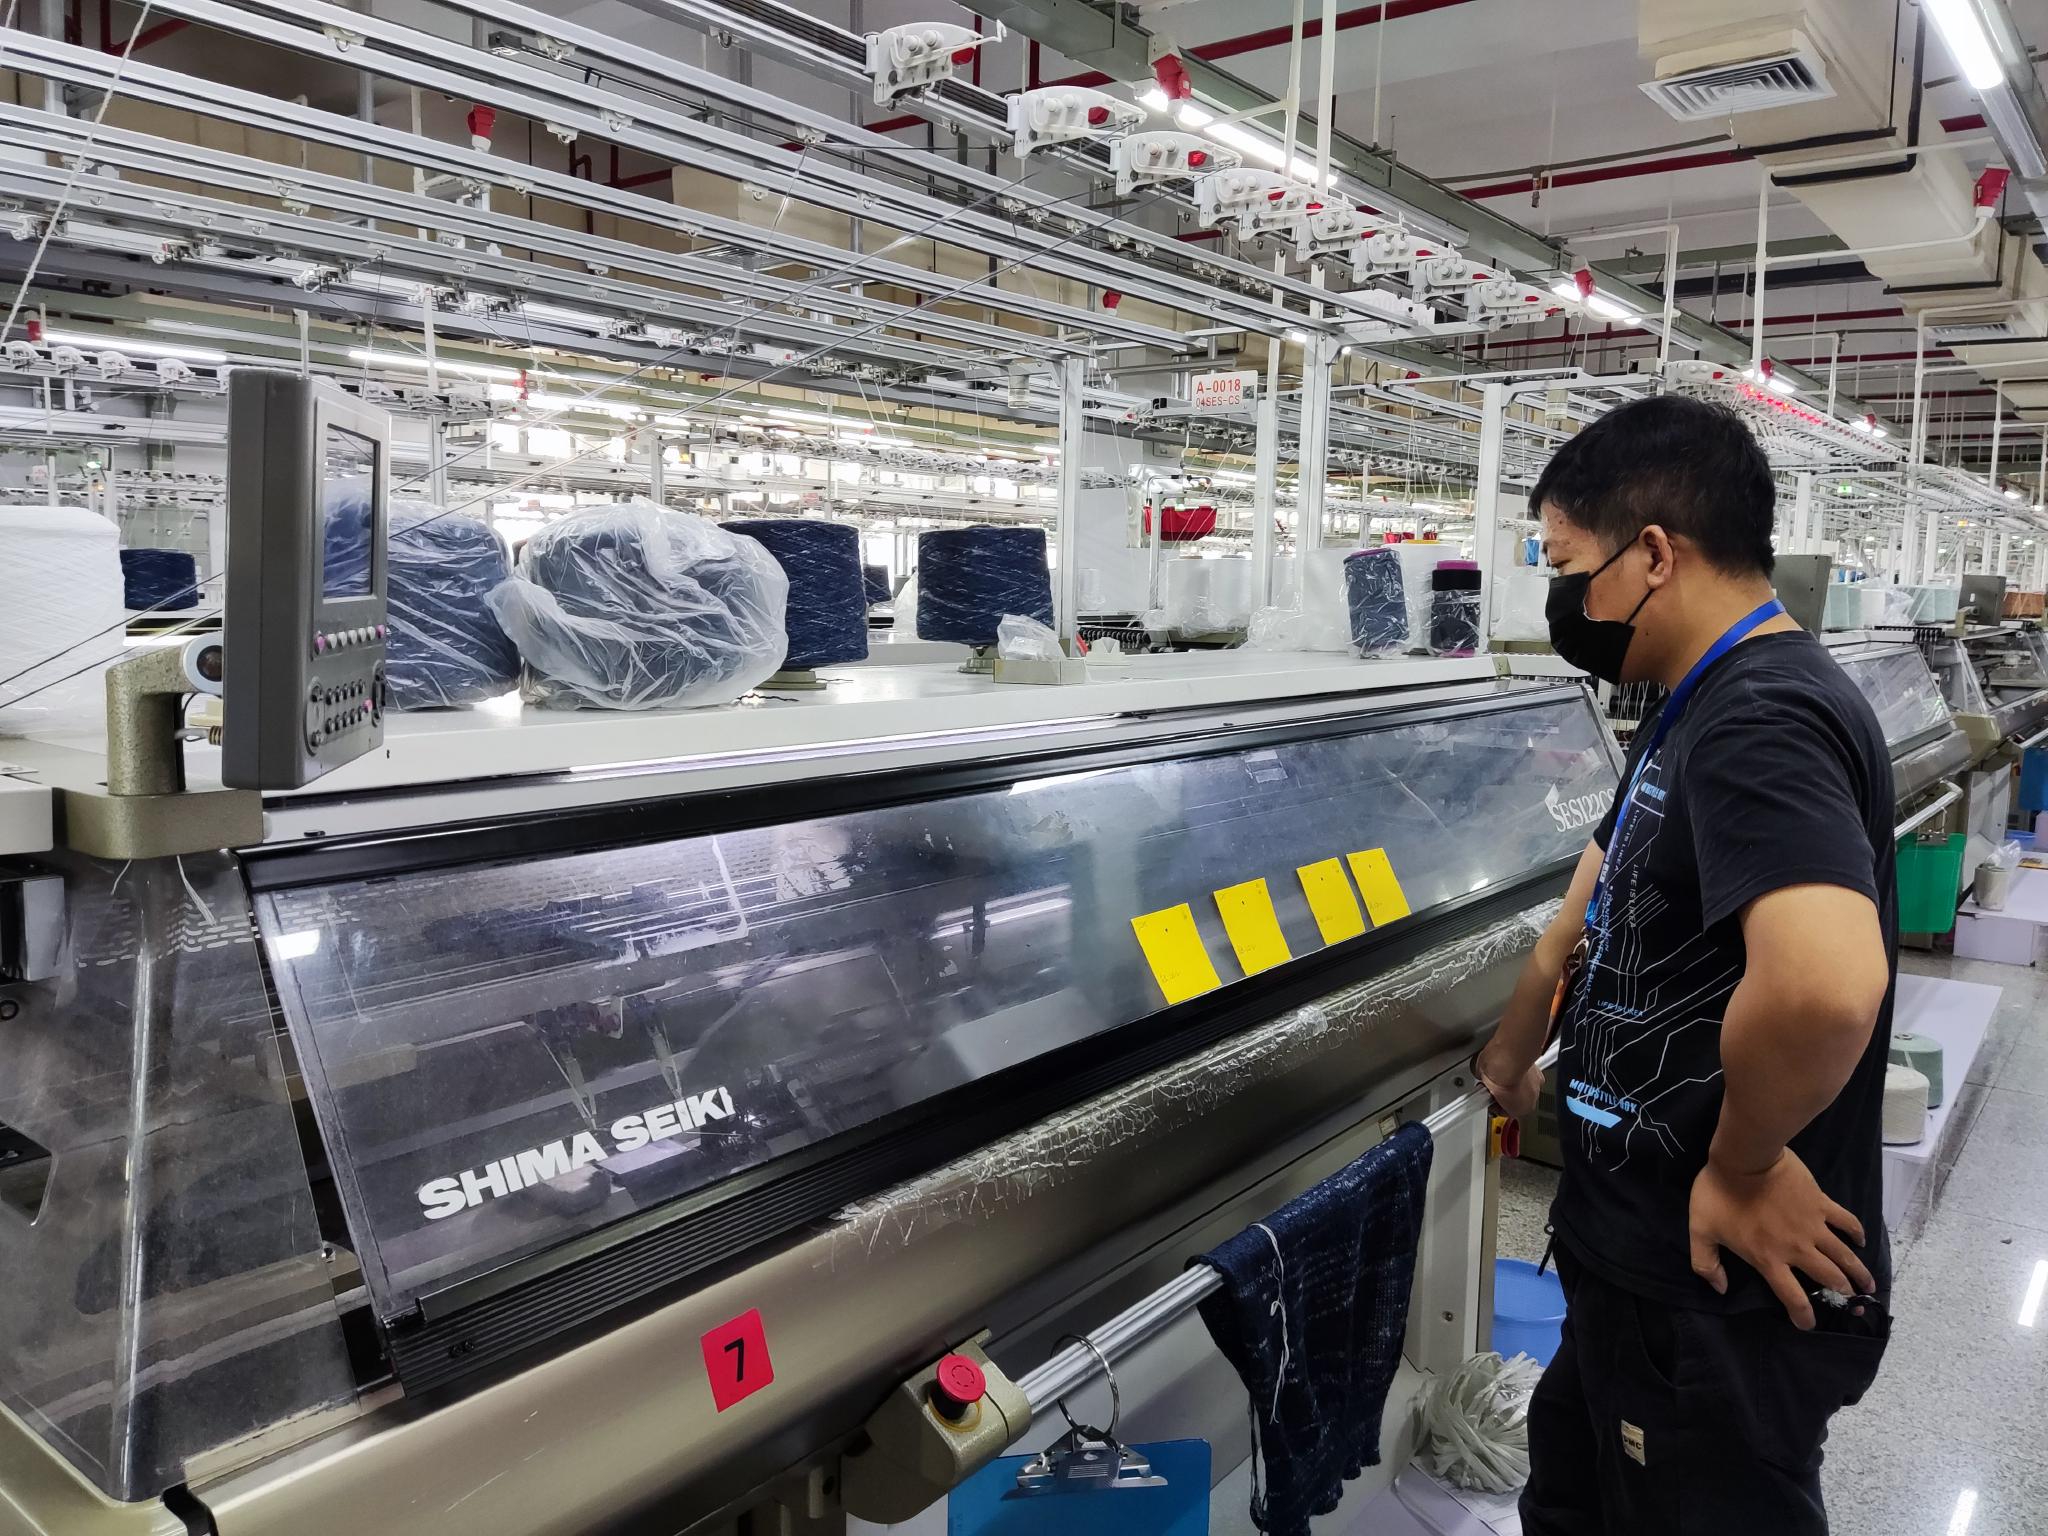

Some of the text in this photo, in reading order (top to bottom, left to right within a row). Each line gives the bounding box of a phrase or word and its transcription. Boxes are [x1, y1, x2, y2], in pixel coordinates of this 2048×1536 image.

[1196, 379, 1241, 394] A-0018
[418, 1086, 736, 1220] SHIMA SEIKI
[724, 1337, 744, 1383] 7
